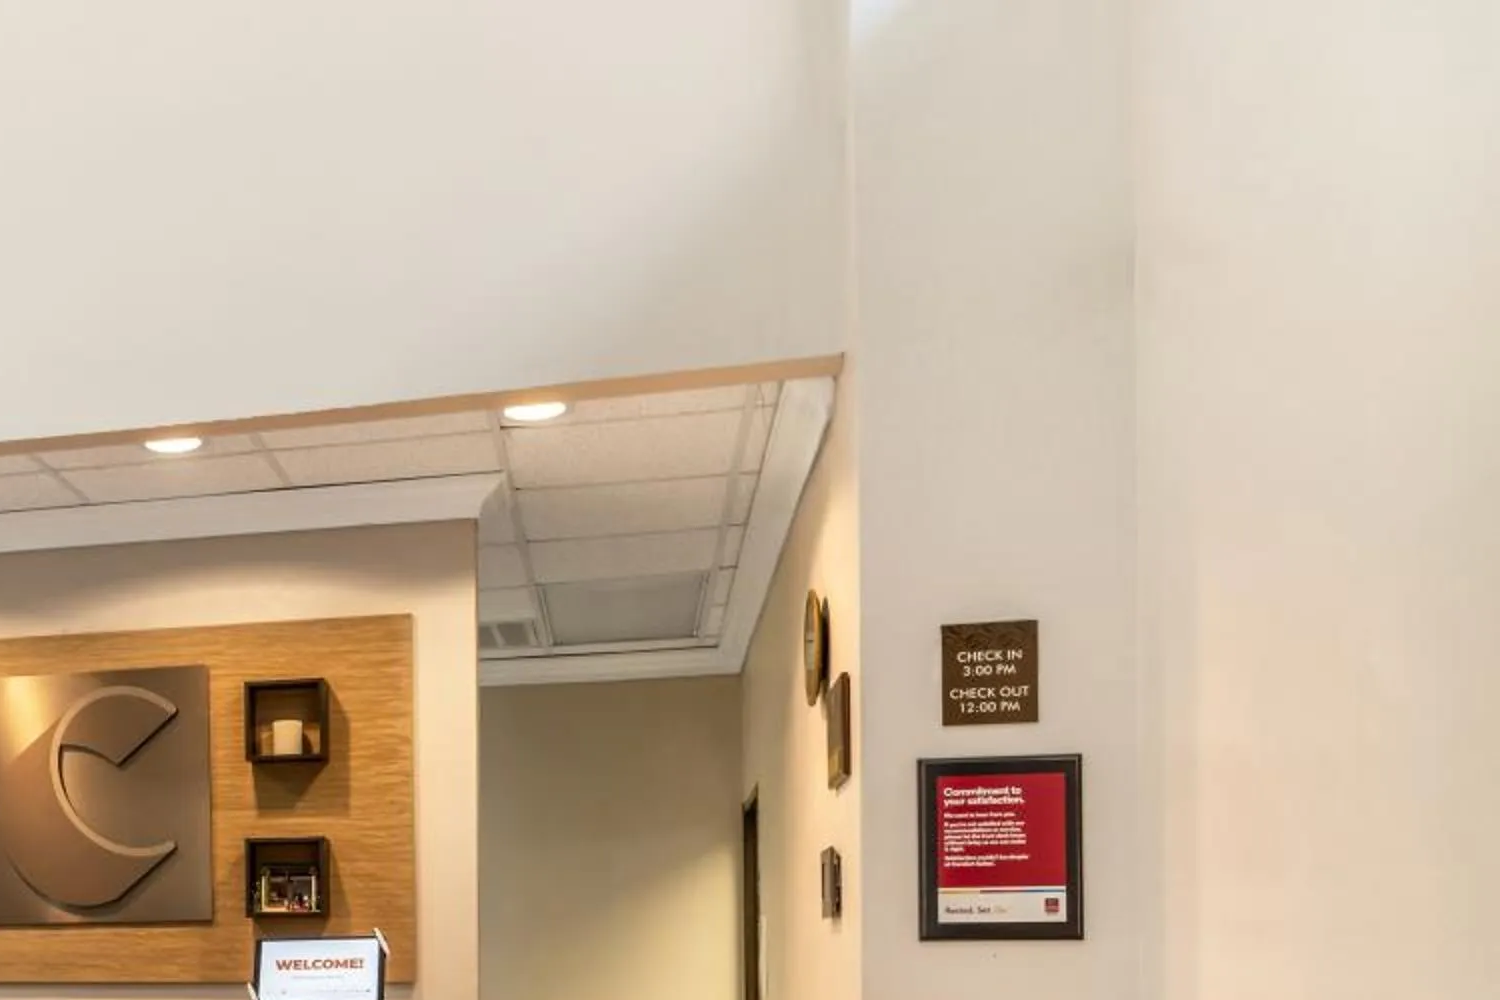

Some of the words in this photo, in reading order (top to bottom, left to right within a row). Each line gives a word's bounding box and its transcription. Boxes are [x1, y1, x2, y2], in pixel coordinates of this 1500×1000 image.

[957, 651, 1003, 663] CHECK
[1007, 649, 1022, 660] IN
[963, 665, 992, 677] 3:00
[996, 664, 1016, 674] PM
[949, 687, 995, 699] CHECK
[1000, 686, 1030, 697] OUT
[960, 702, 996, 713] 12:00
[1000, 701, 1020, 711] PM
[943, 786, 1009, 797] Commitment
[1011, 786, 1022, 795] to
[943, 799, 964, 807] your
[276, 959, 364, 971] WELCOME!
